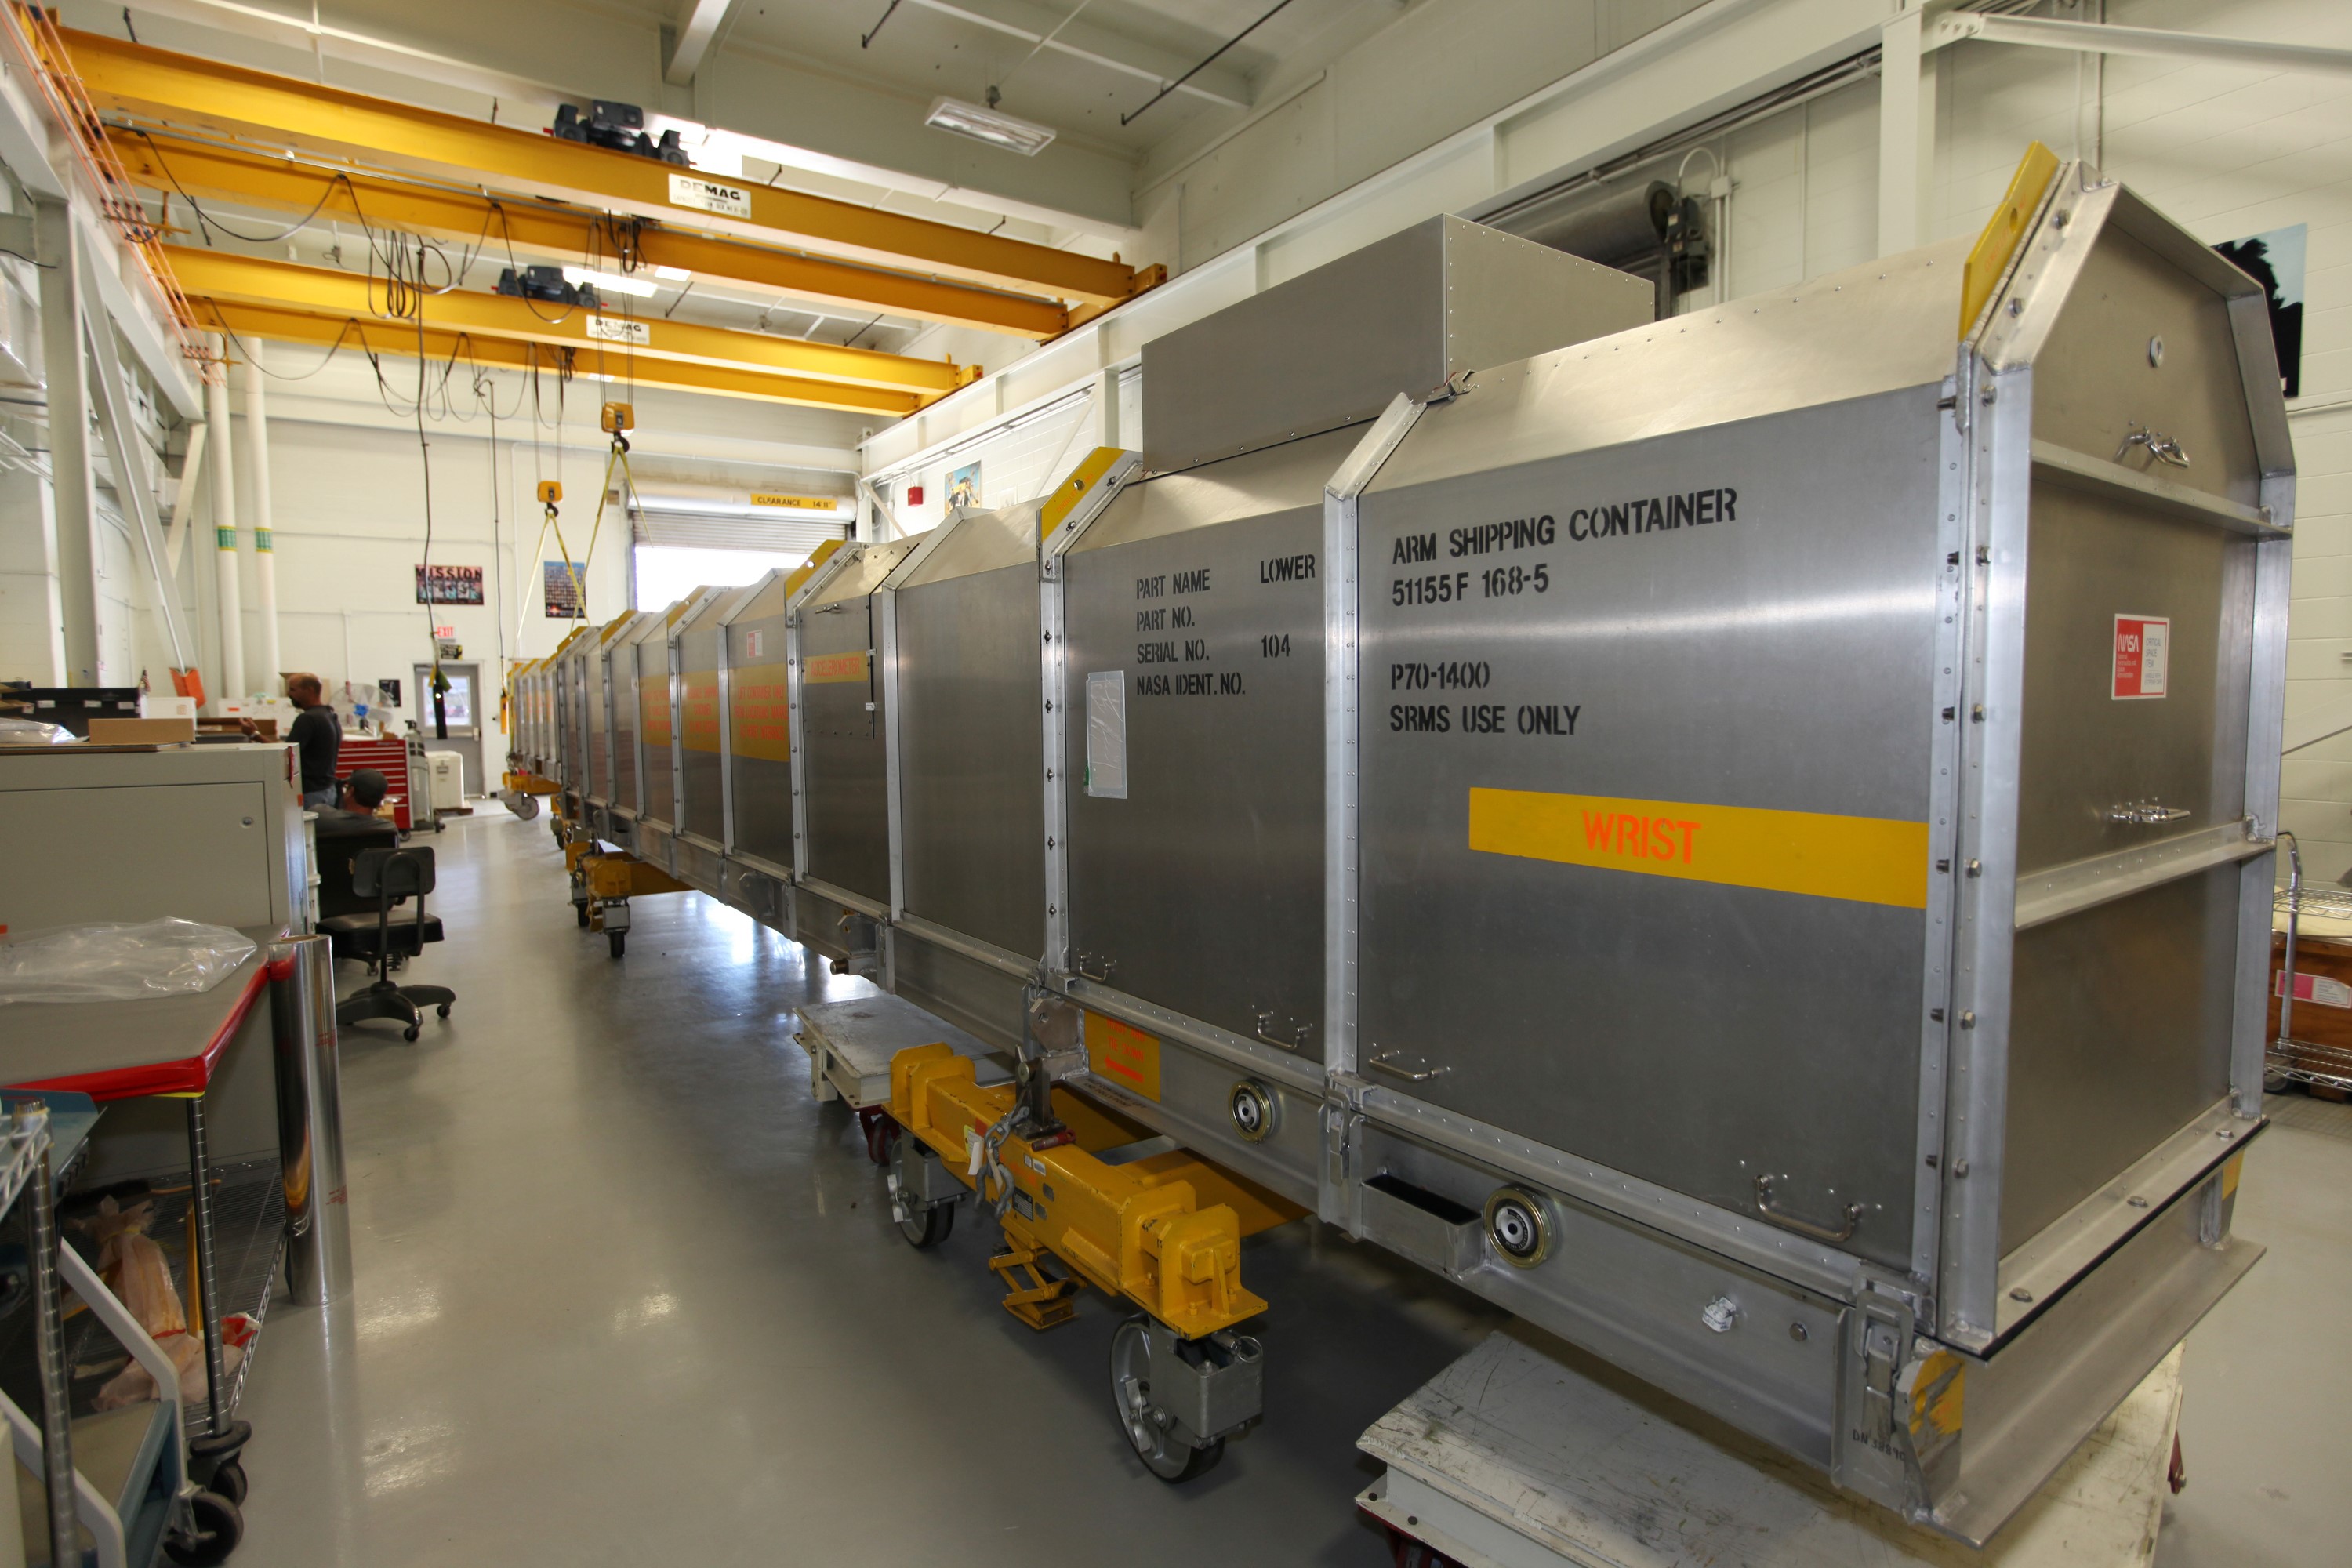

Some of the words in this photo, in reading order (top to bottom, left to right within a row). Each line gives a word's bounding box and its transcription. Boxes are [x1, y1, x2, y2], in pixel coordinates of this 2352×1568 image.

[680, 179, 741, 201] DEMAG
[757, 496, 801, 506] CLEARANCE
[1392, 532, 1437, 565] ARM
[1449, 514, 1555, 559] SHIPPING
[1569, 488, 1737, 543] CONTAINER
[416, 567, 483, 579] MISSION
[1136, 575, 1166, 600] PART
[1173, 568, 1210, 594] NAME
[1261, 554, 1316, 584] LOWER
[1482, 563, 1549, 599] 168-5
[437, 626, 454, 637] EXIT
[1136, 608, 1166, 632] PART
[1172, 606, 1196, 629] NO.
[1137, 641, 1178, 664] SERIAL
[1185, 639, 1210, 661] NO.
[1261, 633, 1290, 658] 104
[2118, 633, 2140, 652] NASA
[811, 656, 861, 678] ACCELEROMETER
[1391, 661, 1490, 690] P70-1400
[1137, 674, 1171, 695] NASA
[1390, 705, 1451, 733] SRMS
[1462, 705, 1506, 734] USE
[1518, 705, 1581, 735] ONLY
[1581, 810, 1702, 864] WRIST
[1107, 1036, 1118, 1052] TIE
[1122, 1043, 1144, 1062] DOWN
